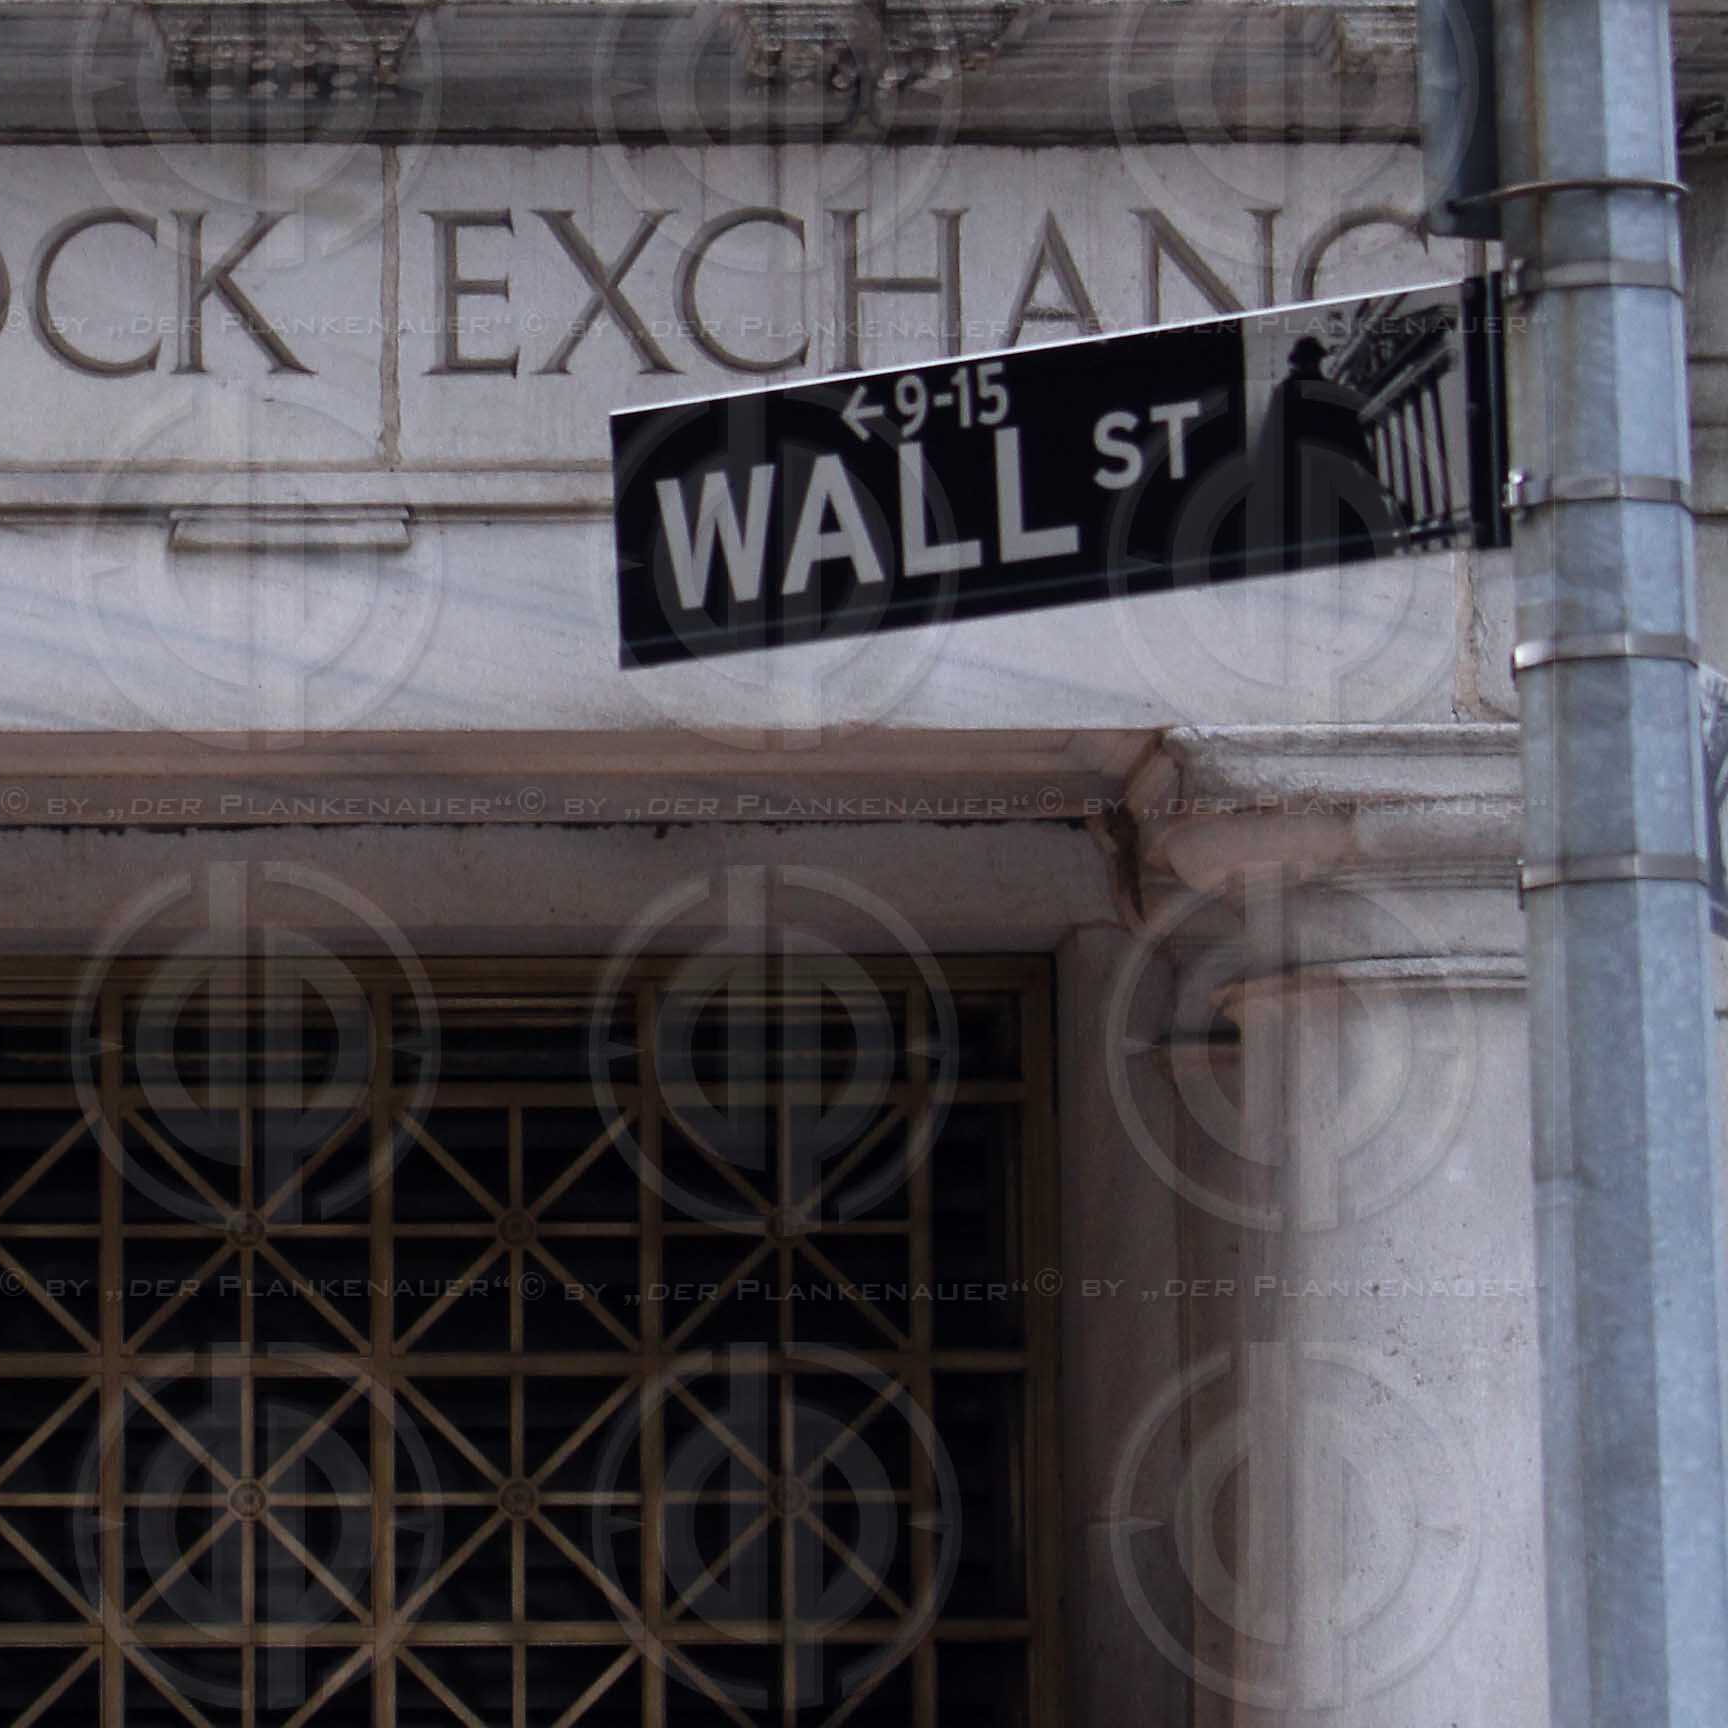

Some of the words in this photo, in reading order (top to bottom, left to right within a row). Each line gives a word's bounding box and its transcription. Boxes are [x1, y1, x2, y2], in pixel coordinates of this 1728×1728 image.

[419, 205, 1429, 378] EXCHAN
[894, 362, 1011, 438] 9-15
[656, 426, 1080, 612] WALL
[1093, 400, 1200, 491] ST
